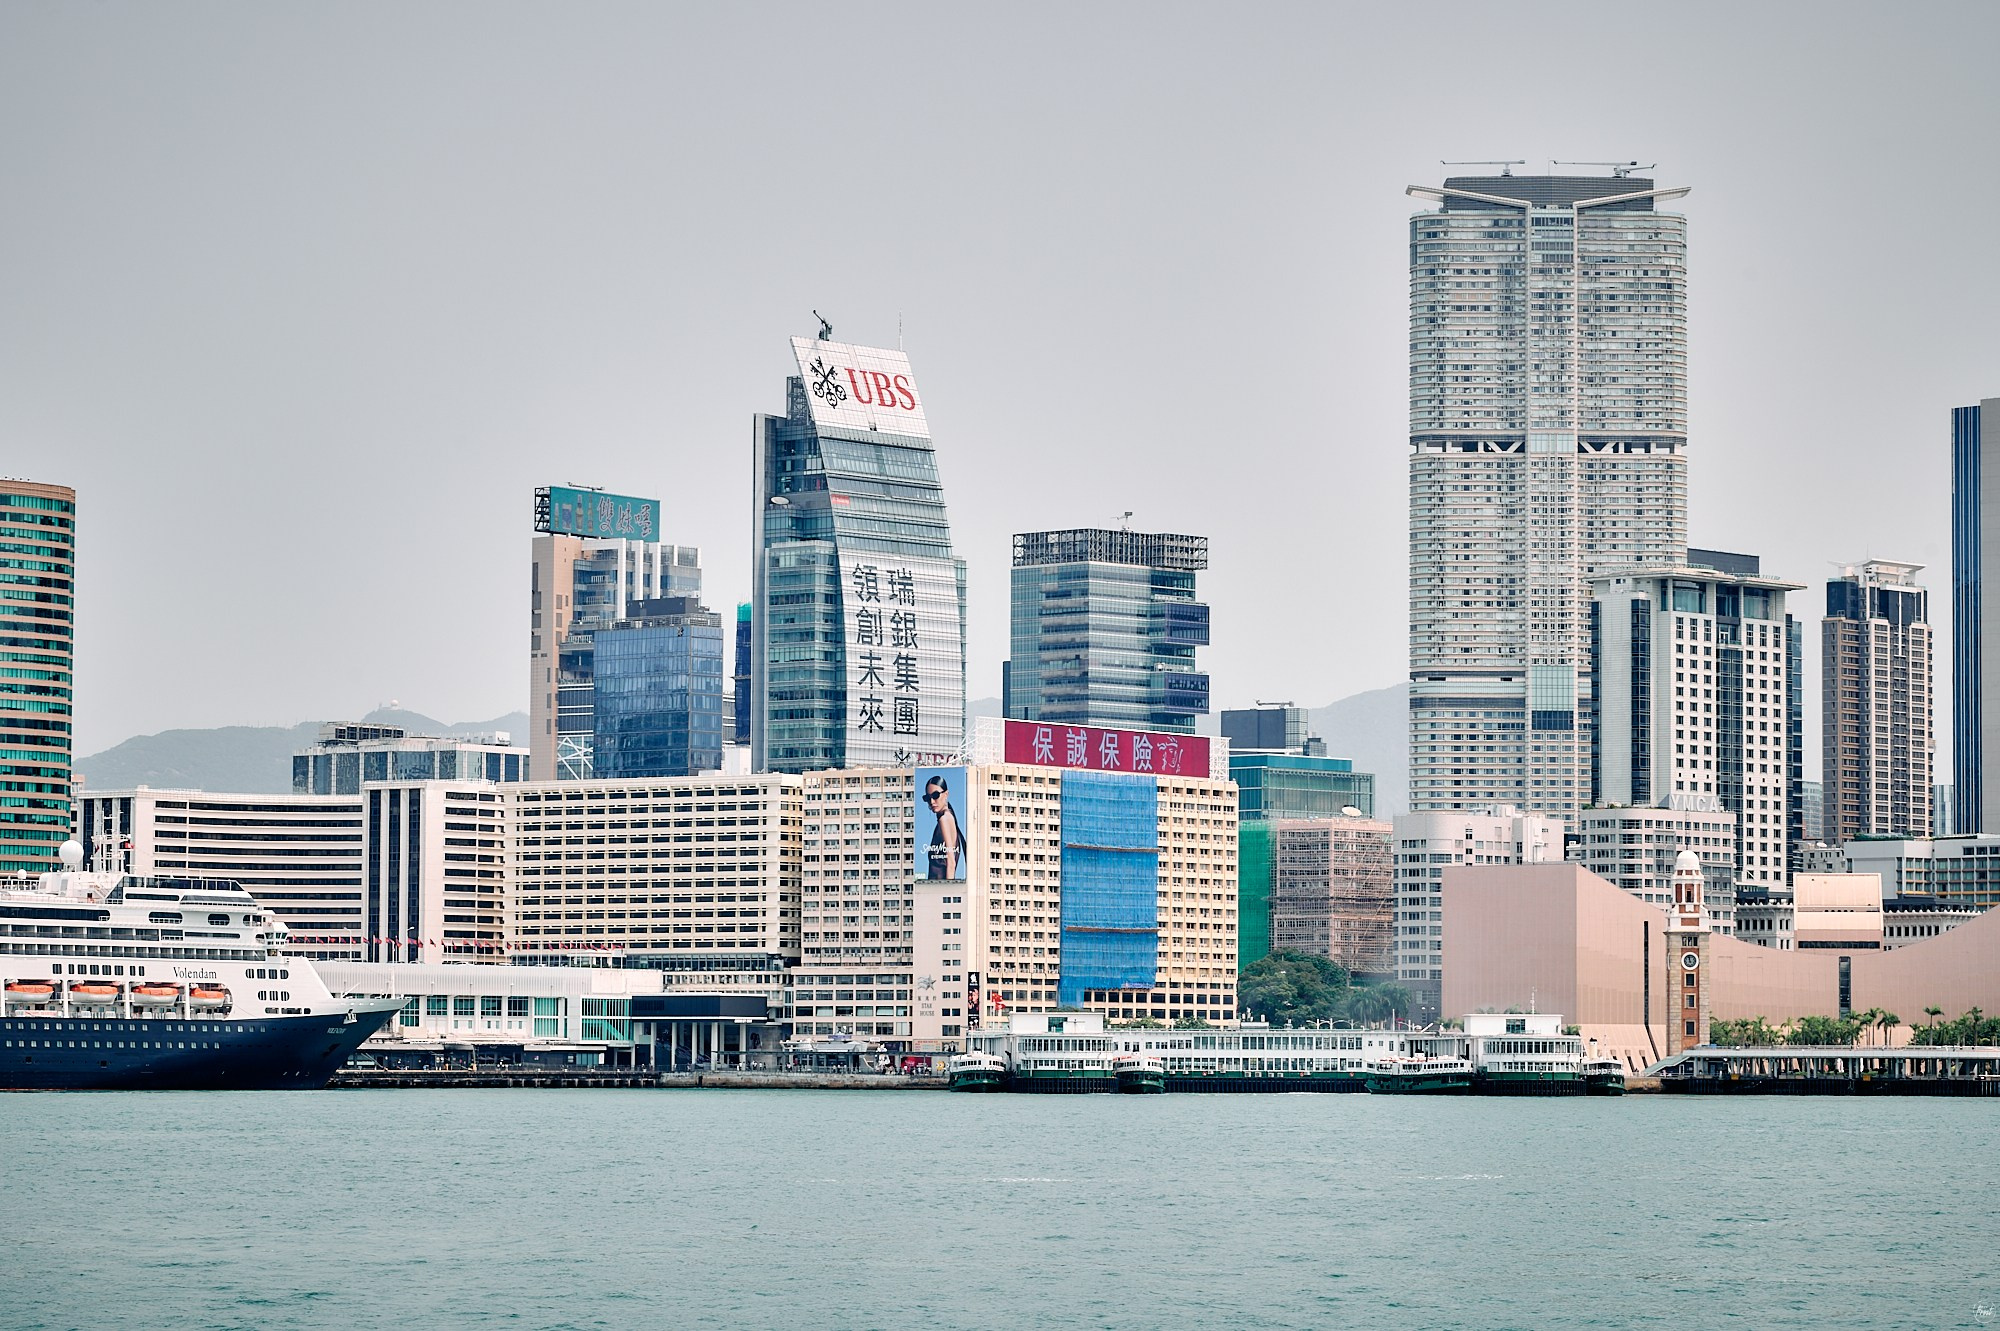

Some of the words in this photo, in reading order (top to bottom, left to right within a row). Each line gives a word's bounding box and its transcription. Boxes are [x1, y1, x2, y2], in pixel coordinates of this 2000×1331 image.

[844, 367, 916, 411] UBS
[852, 563, 885, 733] 領創未來
[886, 567, 920, 736] 瑞銀集團
[1032, 725, 1153, 771] 保誠保險
[1671, 794, 1718, 813] YMCA
[173, 966, 217, 979] Volendam
